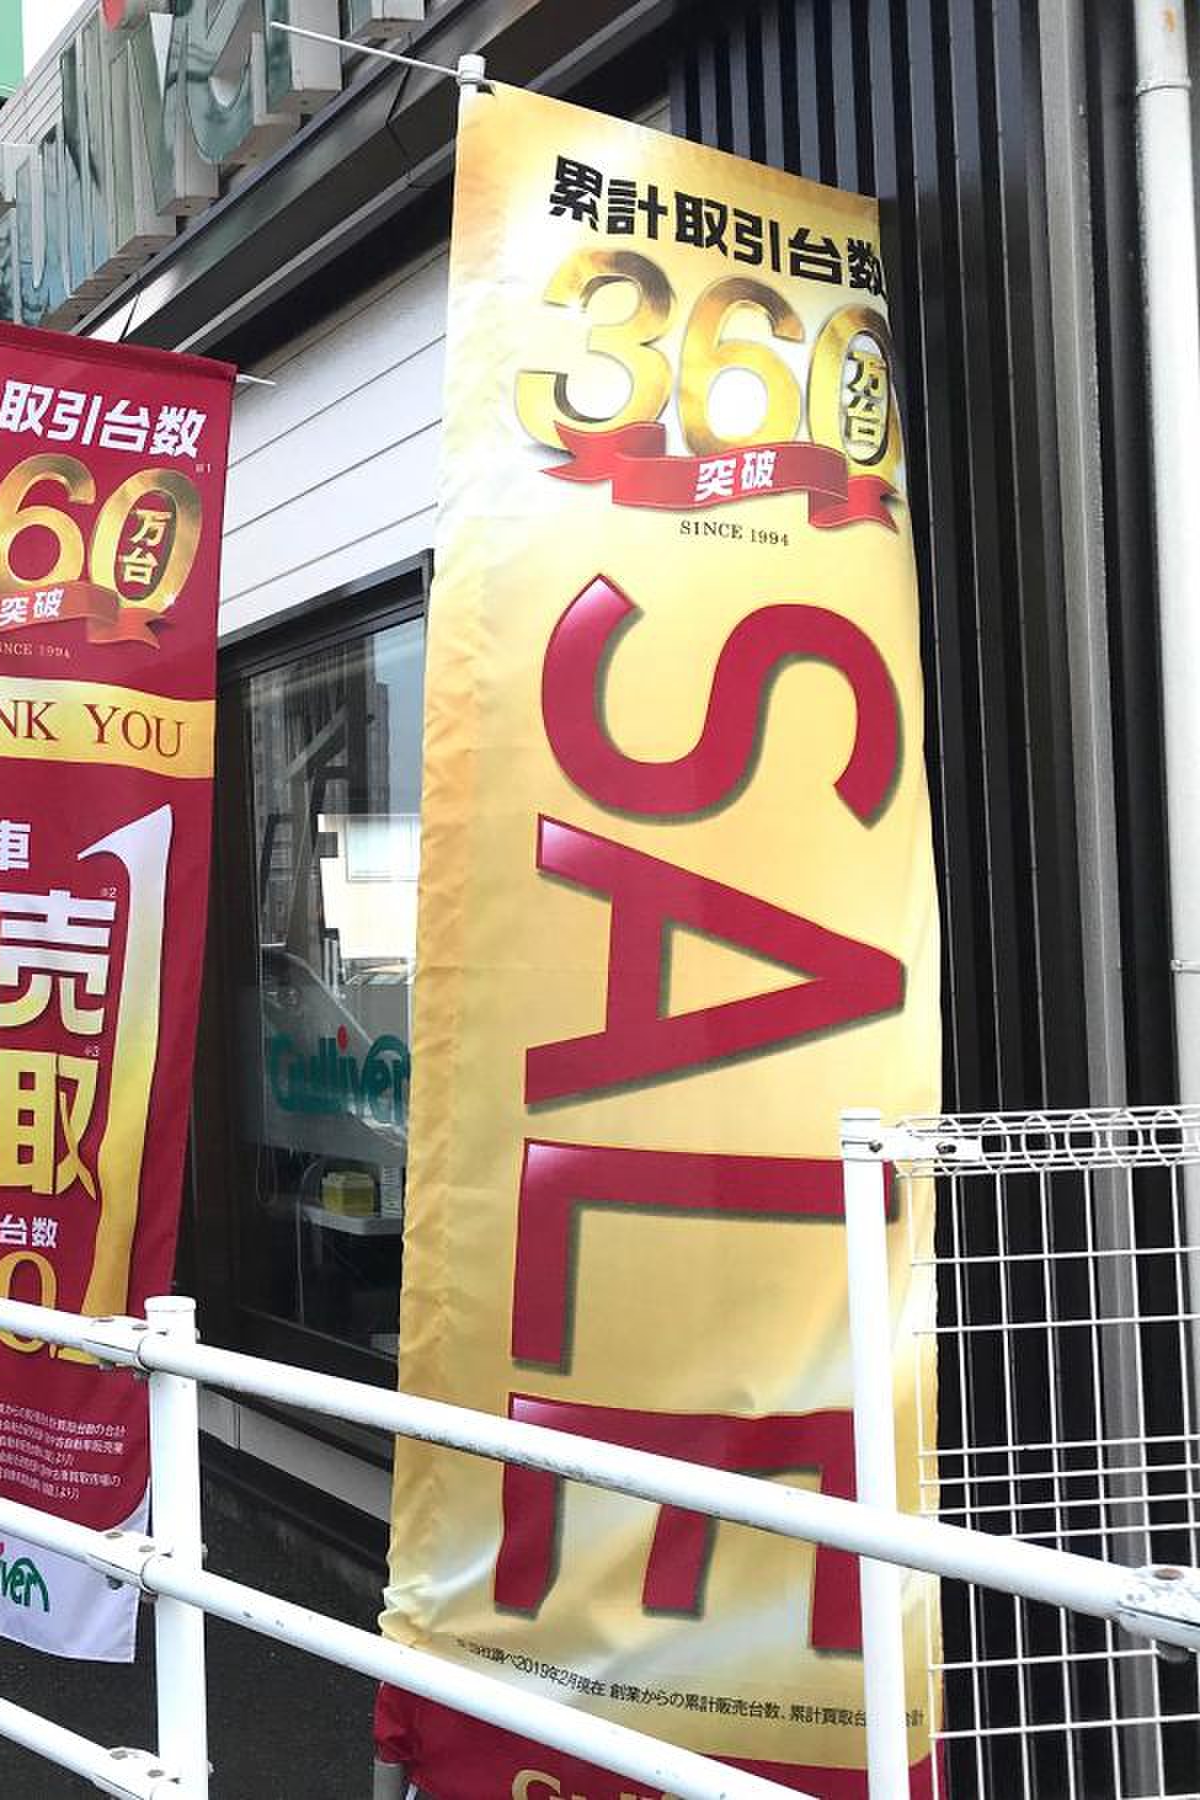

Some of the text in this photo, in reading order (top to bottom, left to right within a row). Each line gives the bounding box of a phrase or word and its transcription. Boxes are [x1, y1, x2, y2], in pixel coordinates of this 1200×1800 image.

[549, 155, 888, 300] 累計取引台数
[514, 247, 901, 482] 360
[694, 449, 779, 501] 突破
[119, 508, 173, 587] 万台
[680, 520, 790, 548] SINCE 1994
[83, 703, 186, 759] YOU
[492, 573, 906, 1656] SALE
[0, 1213, 59, 1249] 台数
